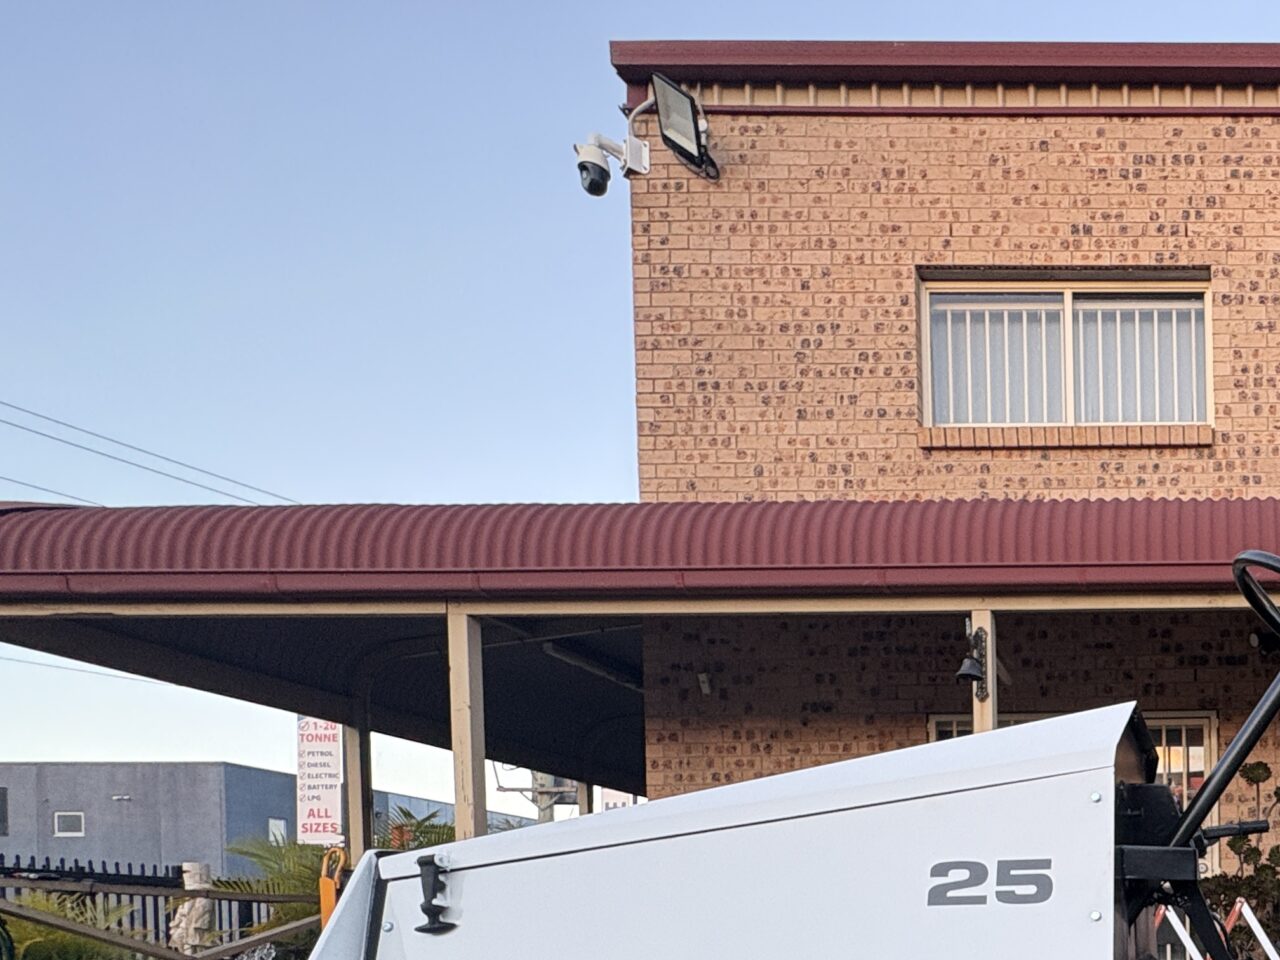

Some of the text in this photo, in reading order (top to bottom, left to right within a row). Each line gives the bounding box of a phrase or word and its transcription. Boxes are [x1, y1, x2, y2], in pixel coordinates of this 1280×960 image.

[299, 733, 338, 743] TONNE
[307, 808, 332, 819] ALL
[301, 822, 338, 834] SIZES
[927, 858, 1054, 906] 25
